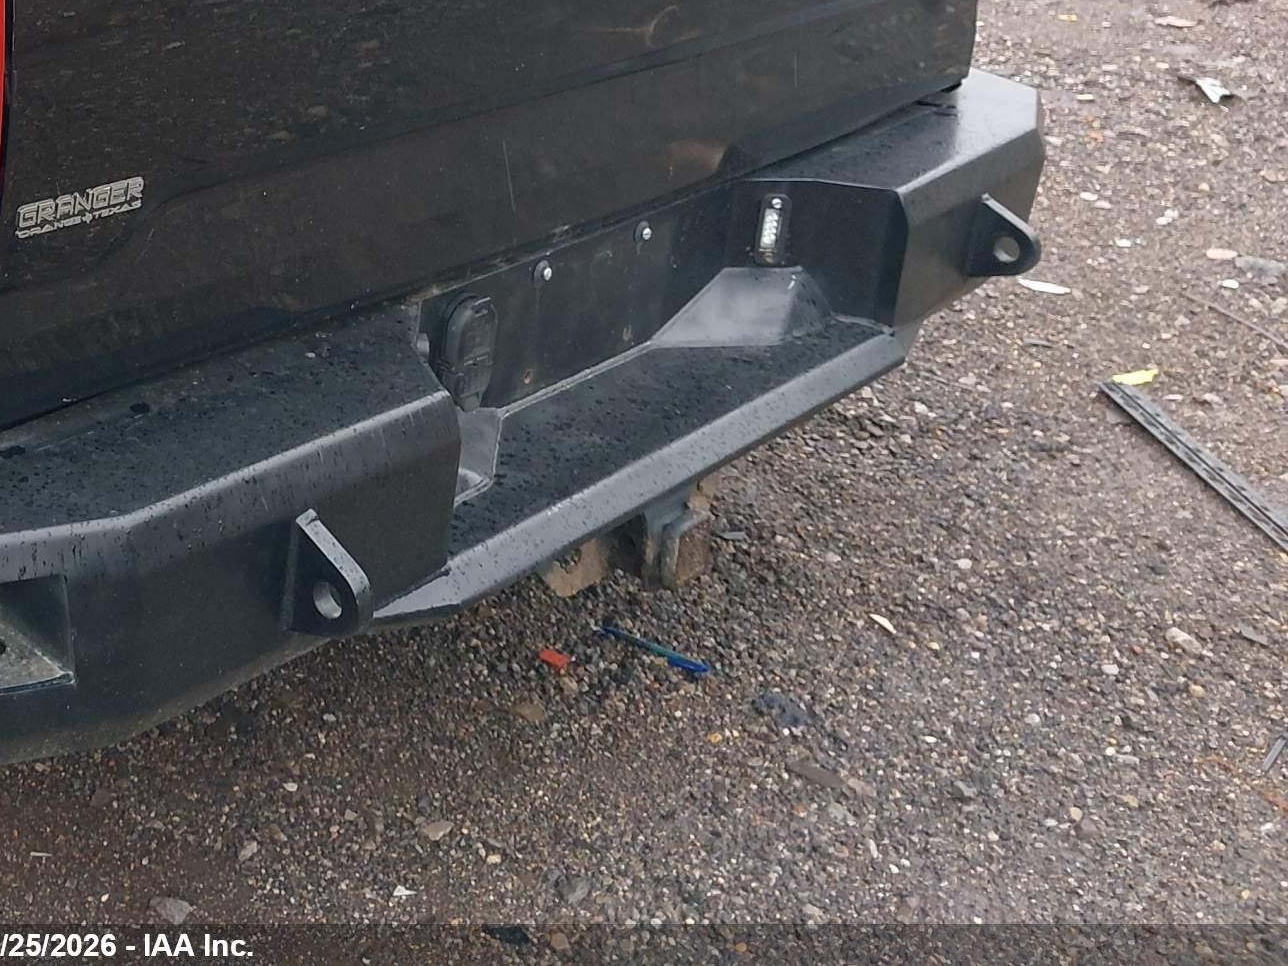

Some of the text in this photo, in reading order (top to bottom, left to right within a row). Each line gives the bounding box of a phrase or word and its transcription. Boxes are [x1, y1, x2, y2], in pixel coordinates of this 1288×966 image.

[15, 199, 143, 239] ORANGE TEXAS
[17, 176, 145, 228] GRANGER
